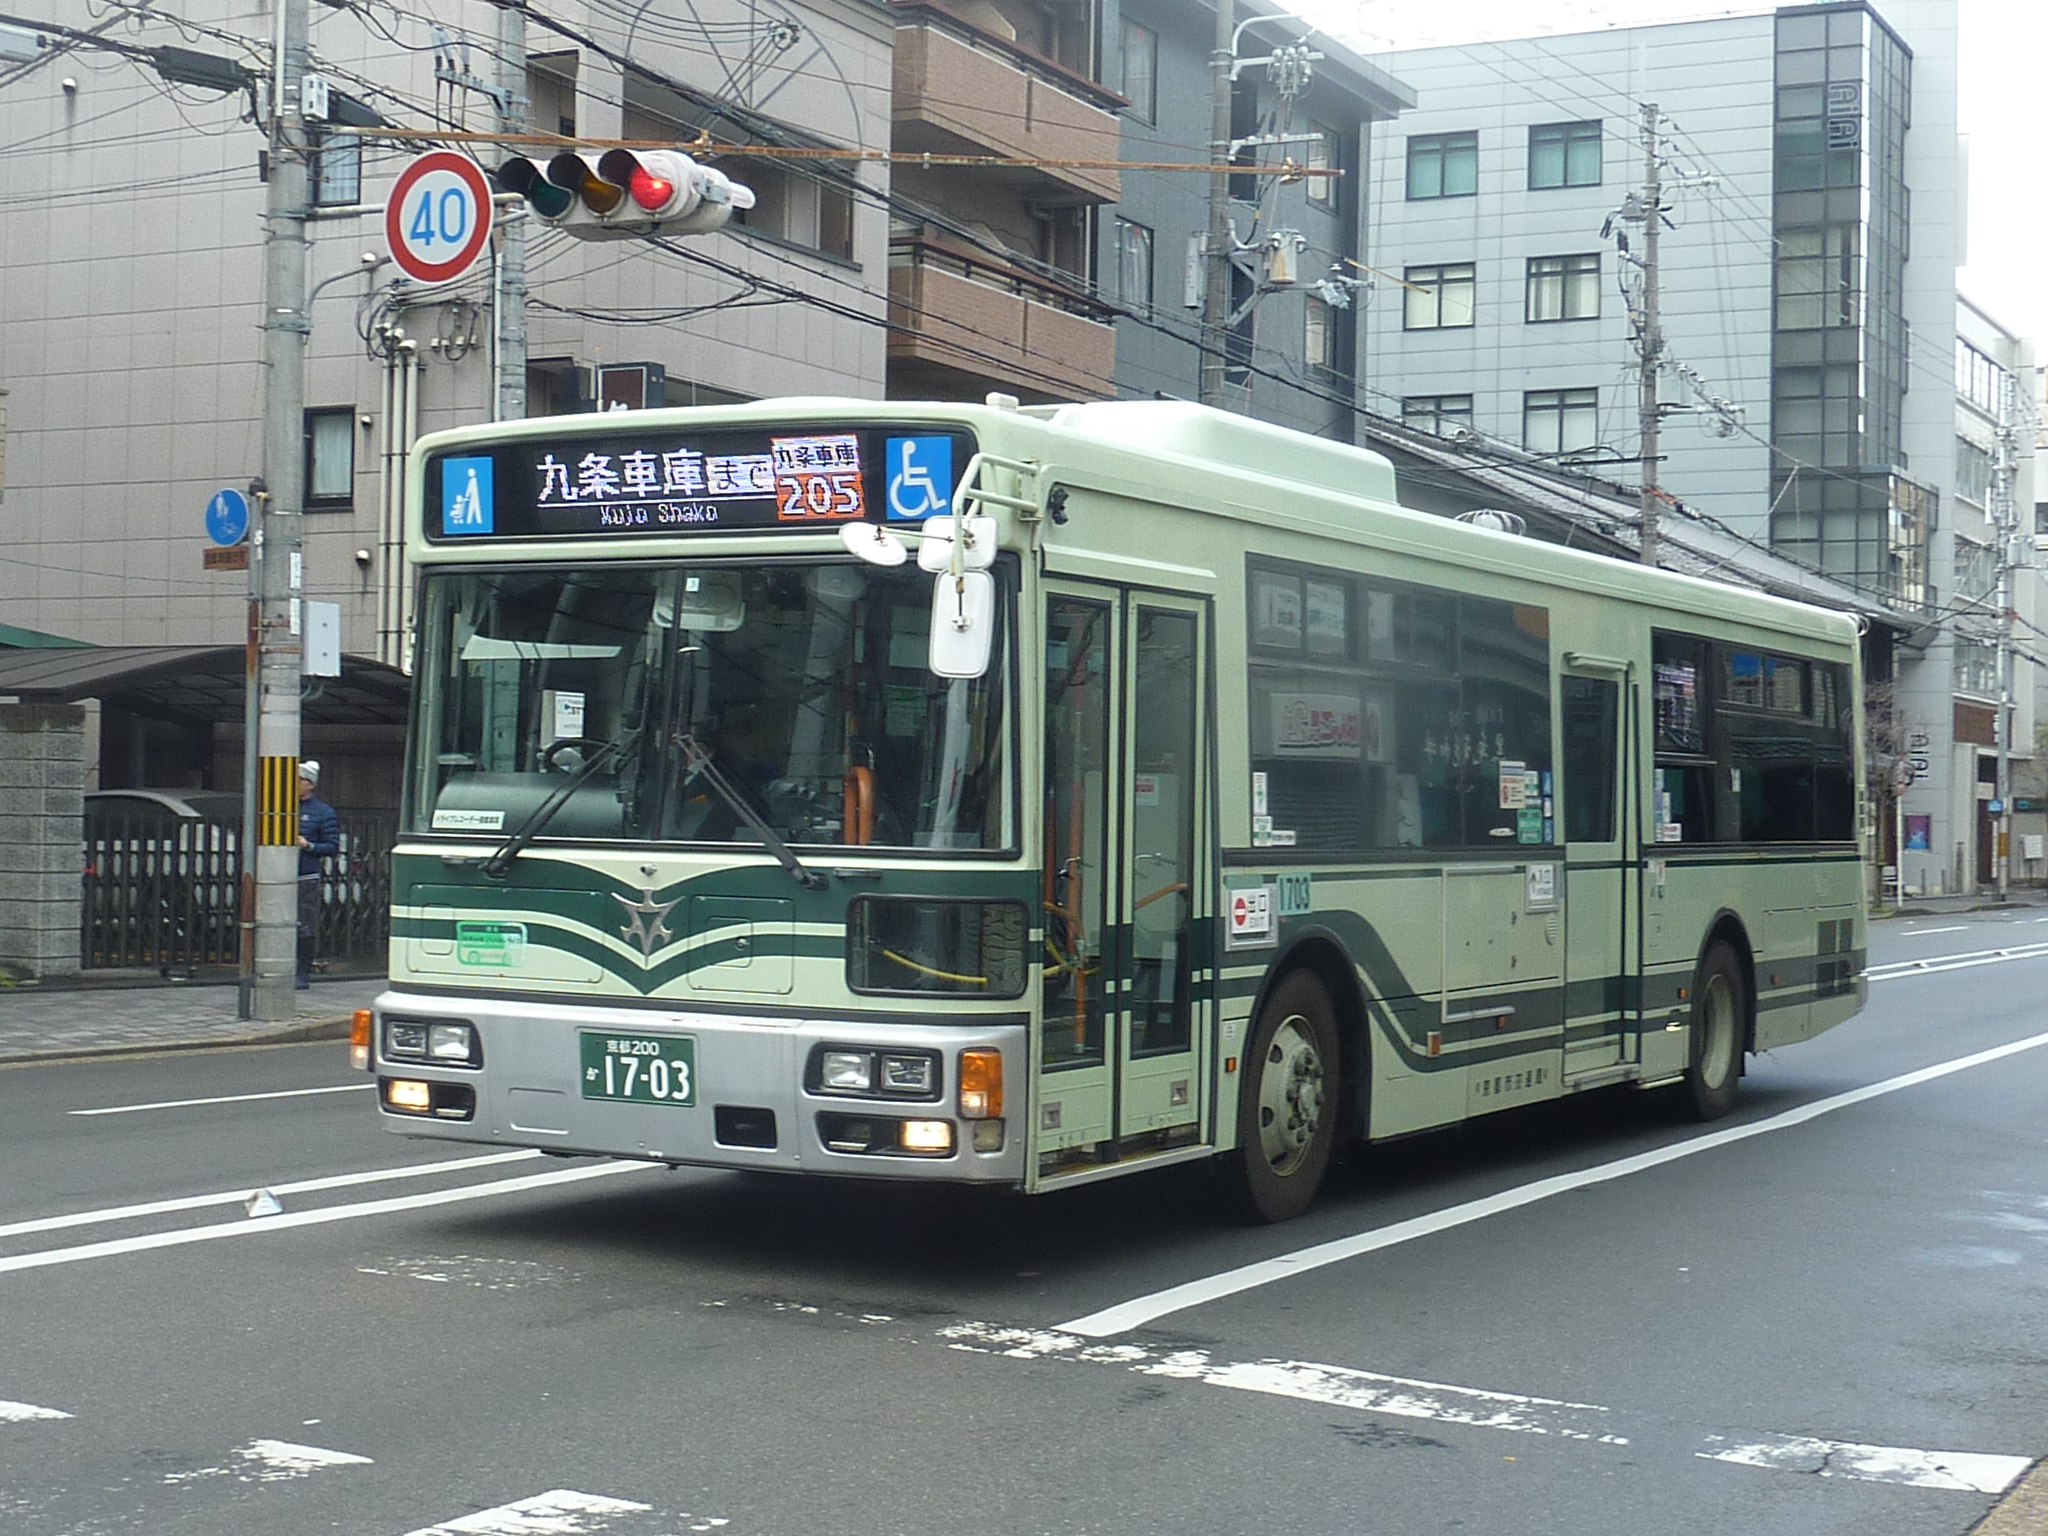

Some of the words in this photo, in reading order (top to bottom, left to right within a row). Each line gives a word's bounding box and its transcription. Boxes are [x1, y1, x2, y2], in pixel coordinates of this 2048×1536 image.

[410, 187, 466, 246] 40
[600, 504, 649, 526] Kujo
[658, 501, 719, 524] Shako
[779, 474, 861, 516] 205
[1279, 876, 1310, 911] 1703
[604, 1055, 690, 1100] 17-03
